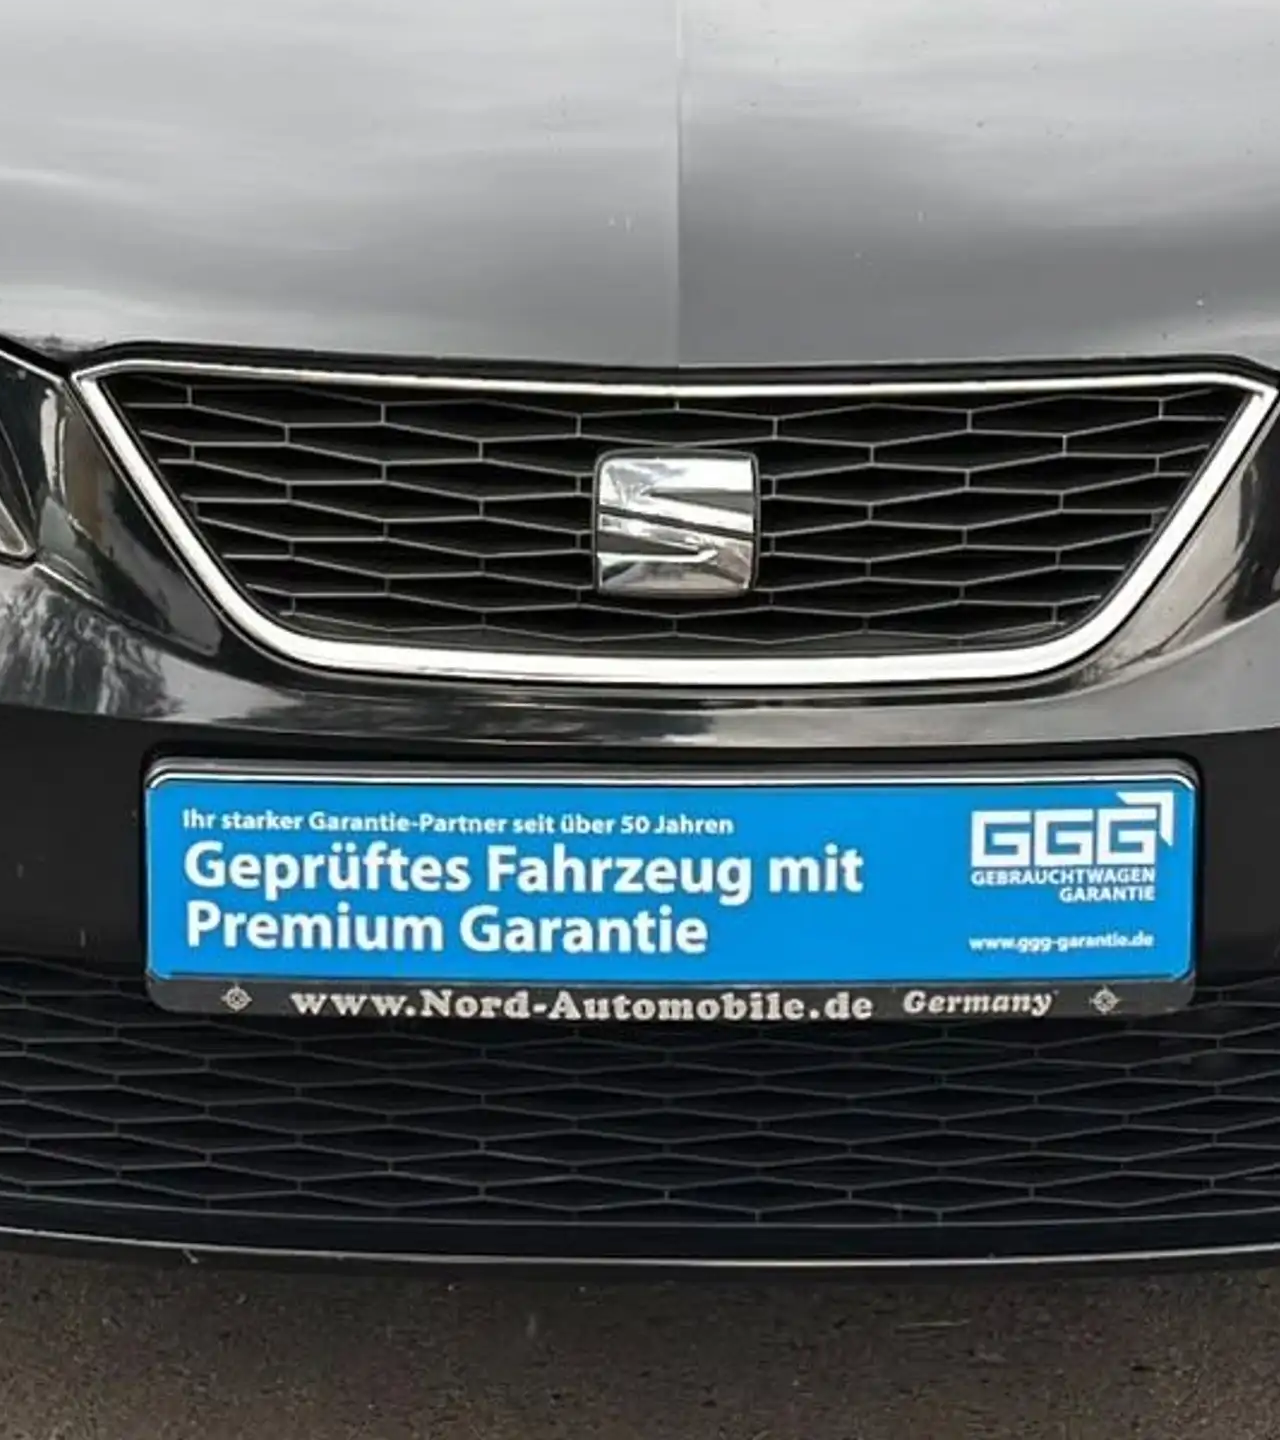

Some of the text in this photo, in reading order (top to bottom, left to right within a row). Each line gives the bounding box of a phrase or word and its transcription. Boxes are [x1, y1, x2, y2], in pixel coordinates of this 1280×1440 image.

[182, 809, 735, 835] Ihr starker Garantie-Partner seit über 50 Jahren
[970, 808, 1158, 867] GGG
[184, 839, 865, 906] Geprüftes Fahrzeug mit
[970, 866, 1157, 887] GEBRAUCHTWAGEN
[1058, 885, 1157, 904] GARANTIE
[186, 901, 709, 955] Premium Garantie
[969, 930, 1156, 953] www.ggg-garantie.de
[289, 988, 1054, 1022] www.Nord-Automobile.de Germany
